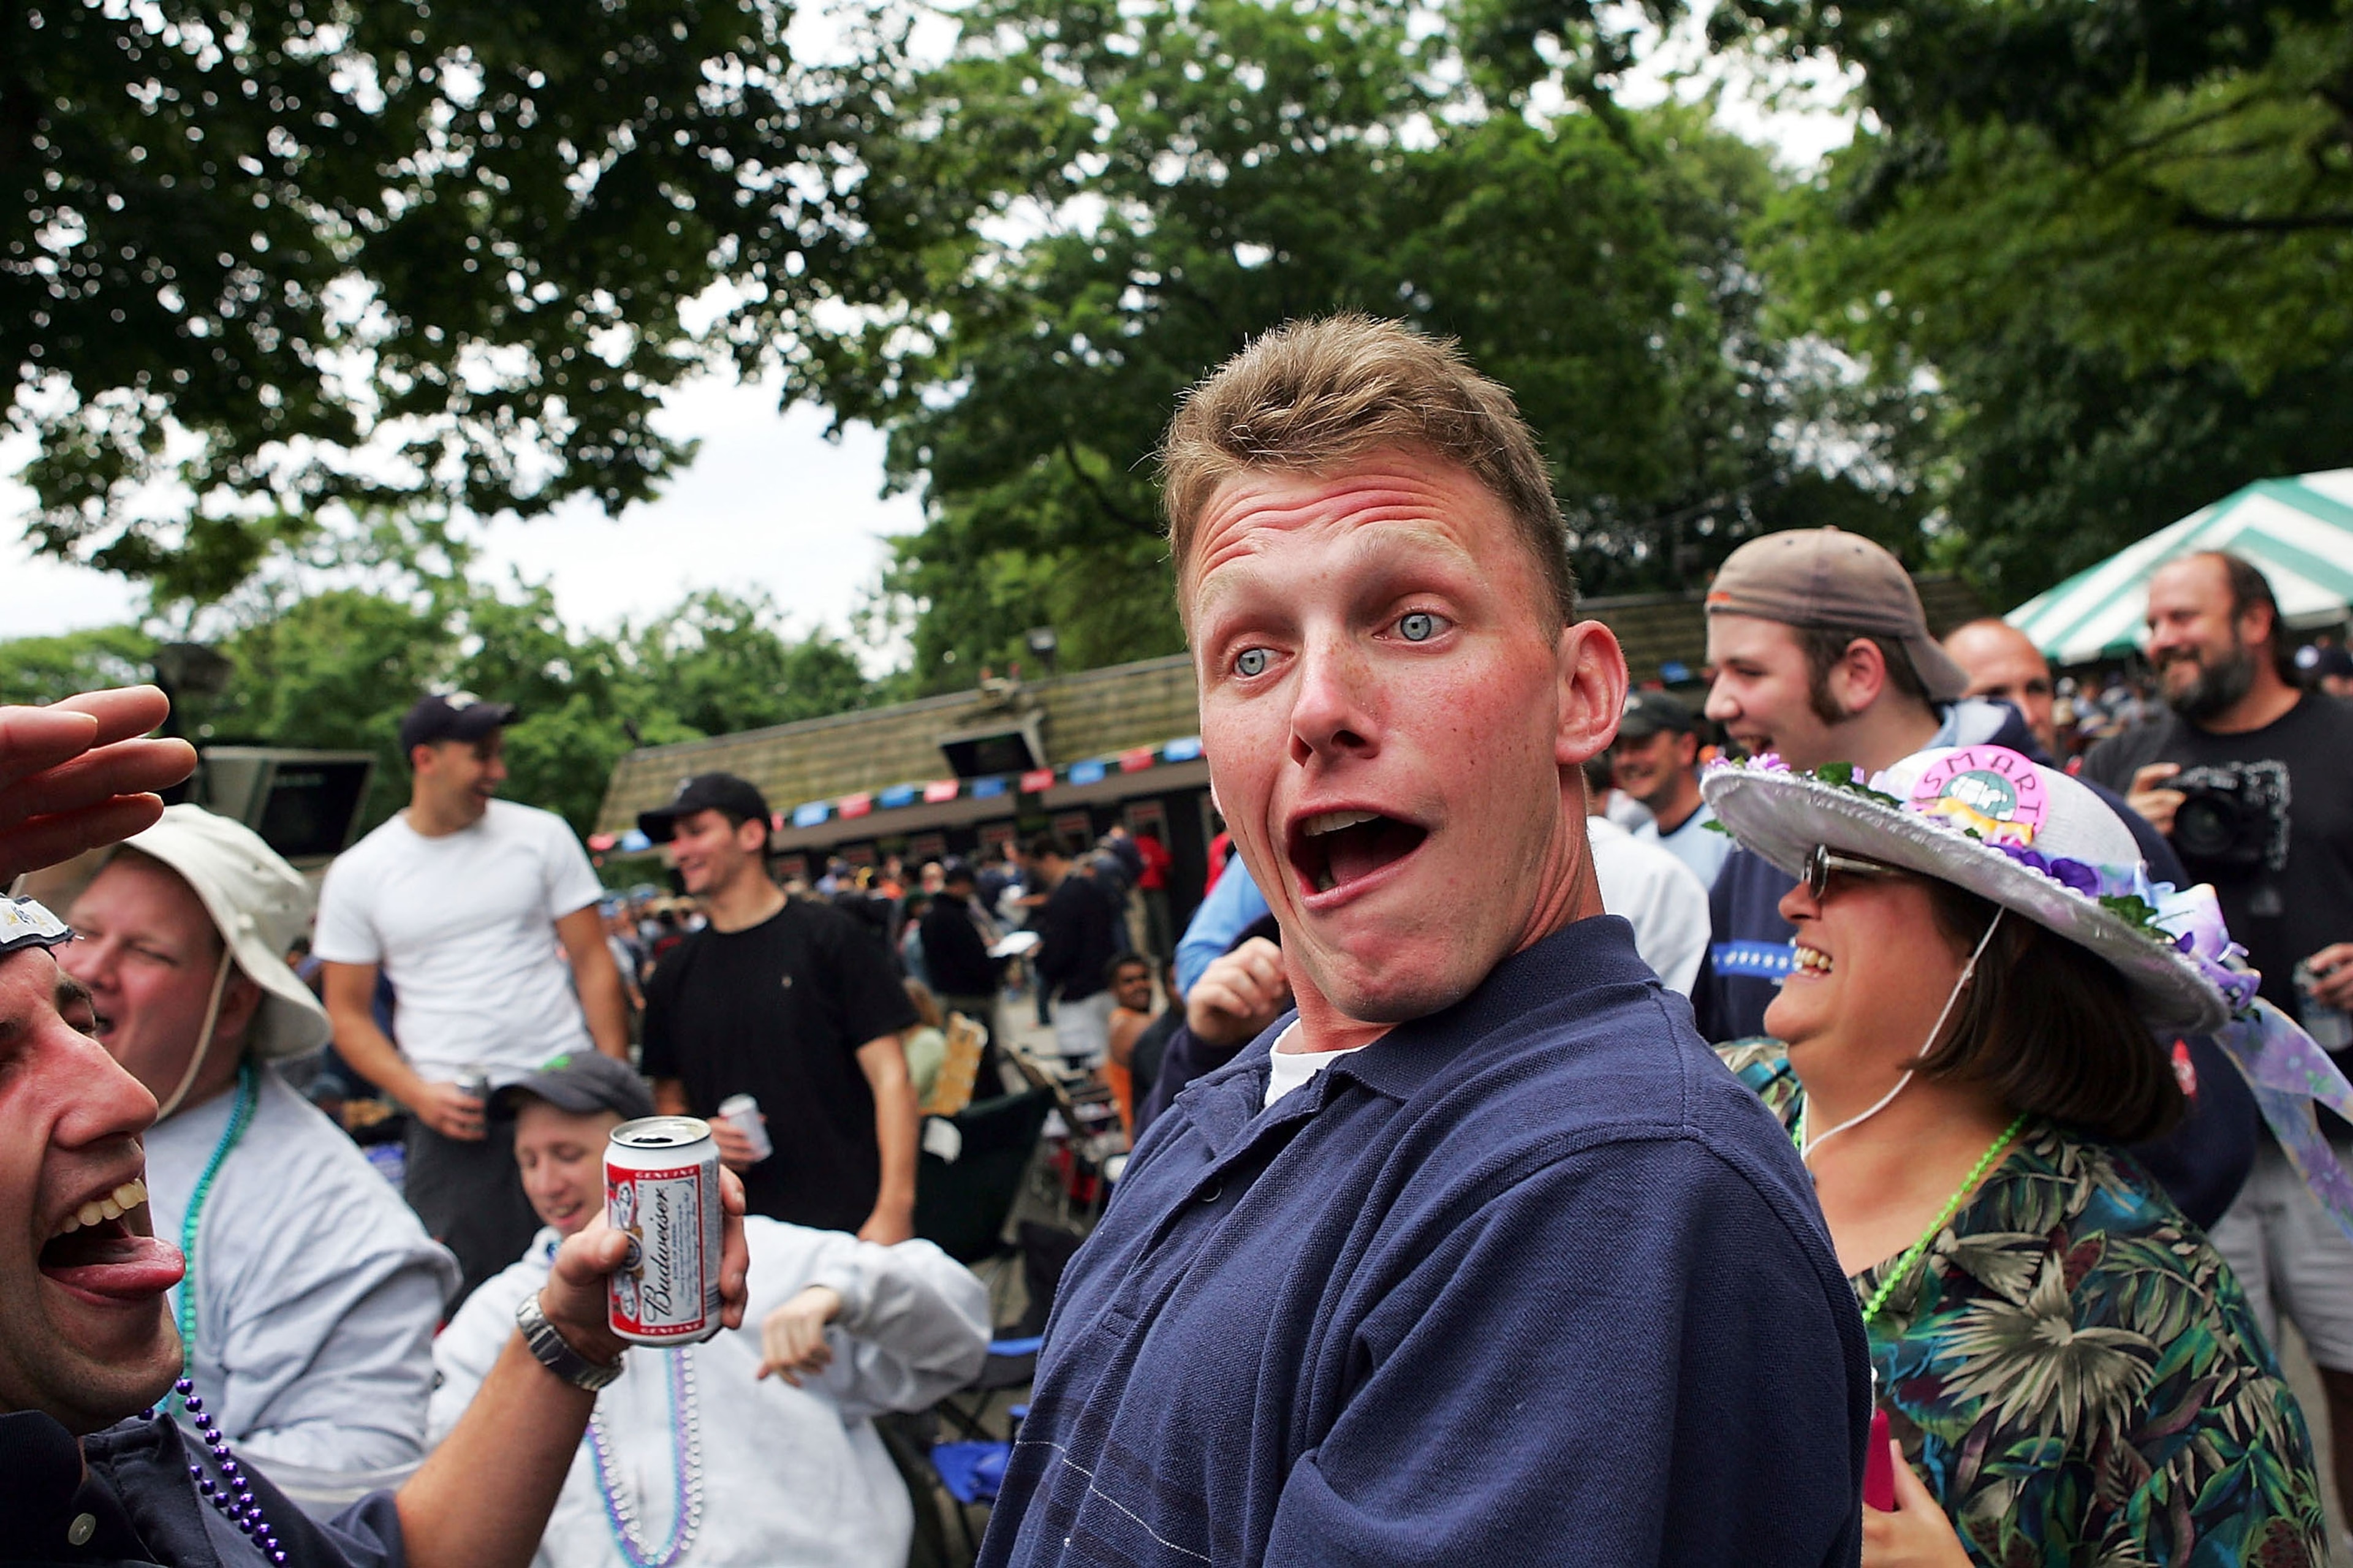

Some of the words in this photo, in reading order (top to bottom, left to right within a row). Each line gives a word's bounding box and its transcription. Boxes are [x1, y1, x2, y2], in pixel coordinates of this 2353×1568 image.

[1924, 752, 2042, 817] SMART
[635, 1168, 695, 1178] GENUINE
[643, 1187, 672, 1322] Budweiser
